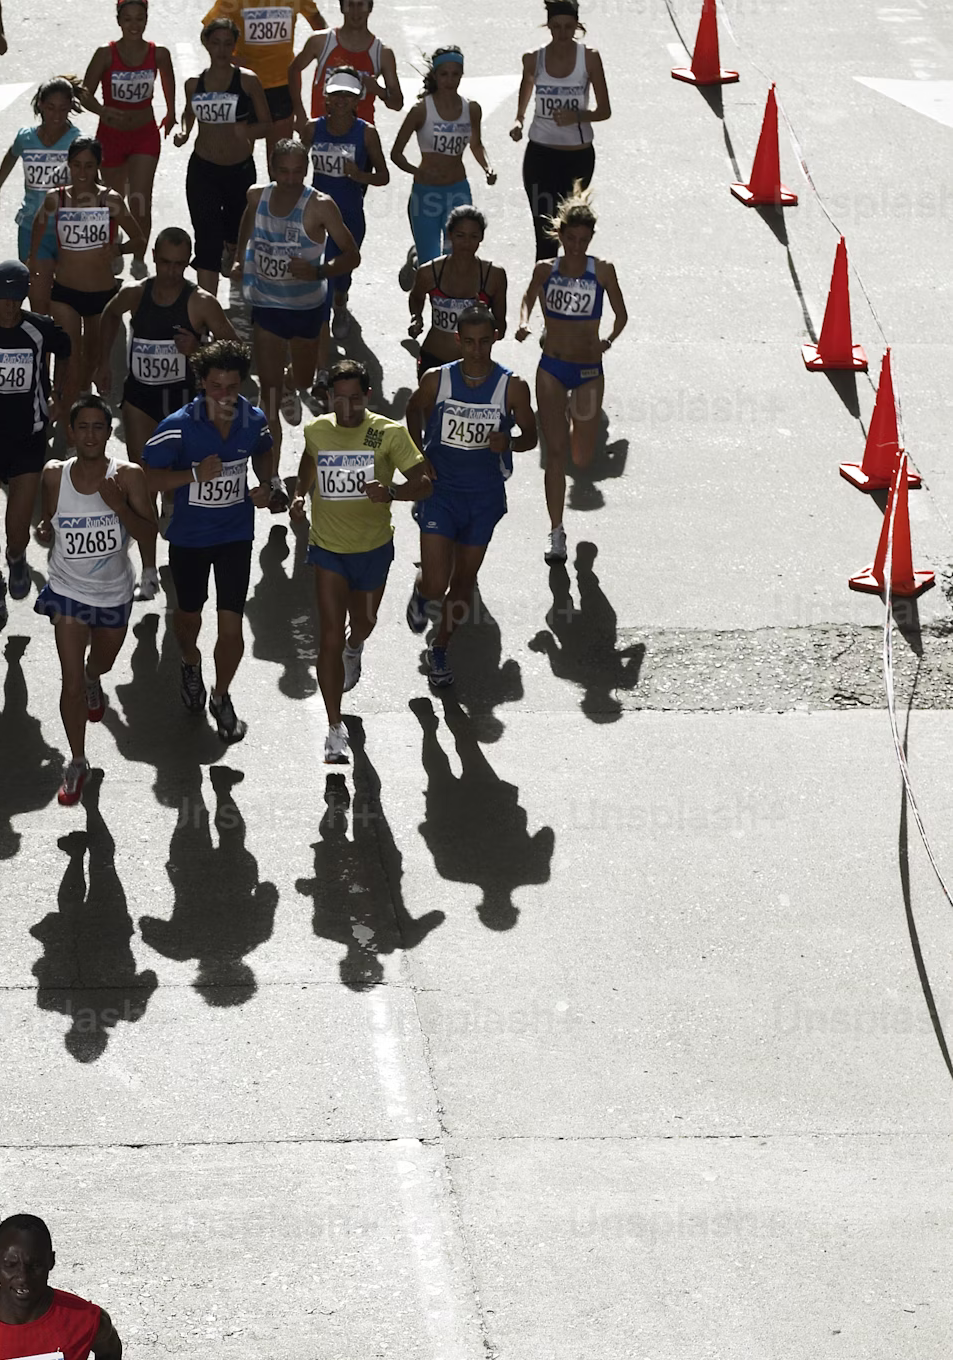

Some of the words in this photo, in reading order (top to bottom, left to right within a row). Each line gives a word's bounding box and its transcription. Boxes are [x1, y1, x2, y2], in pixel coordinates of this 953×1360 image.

[250, 22, 287, 40] 23876
[112, 83, 149, 100] 16542
[196, 102, 232, 121] 23547
[27, 165, 68, 185] 32584
[63, 225, 106, 244] 25486
[548, 289, 591, 313] 48932
[2, 353, 33, 364] RunStyle
[136, 357, 180, 379] 13594
[469, 409, 500, 420] RunStyle
[448, 420, 494, 443] 24587
[198, 478, 240, 501] 13594
[85, 516, 120, 528] RunStyle
[66, 529, 117, 555] 32685
